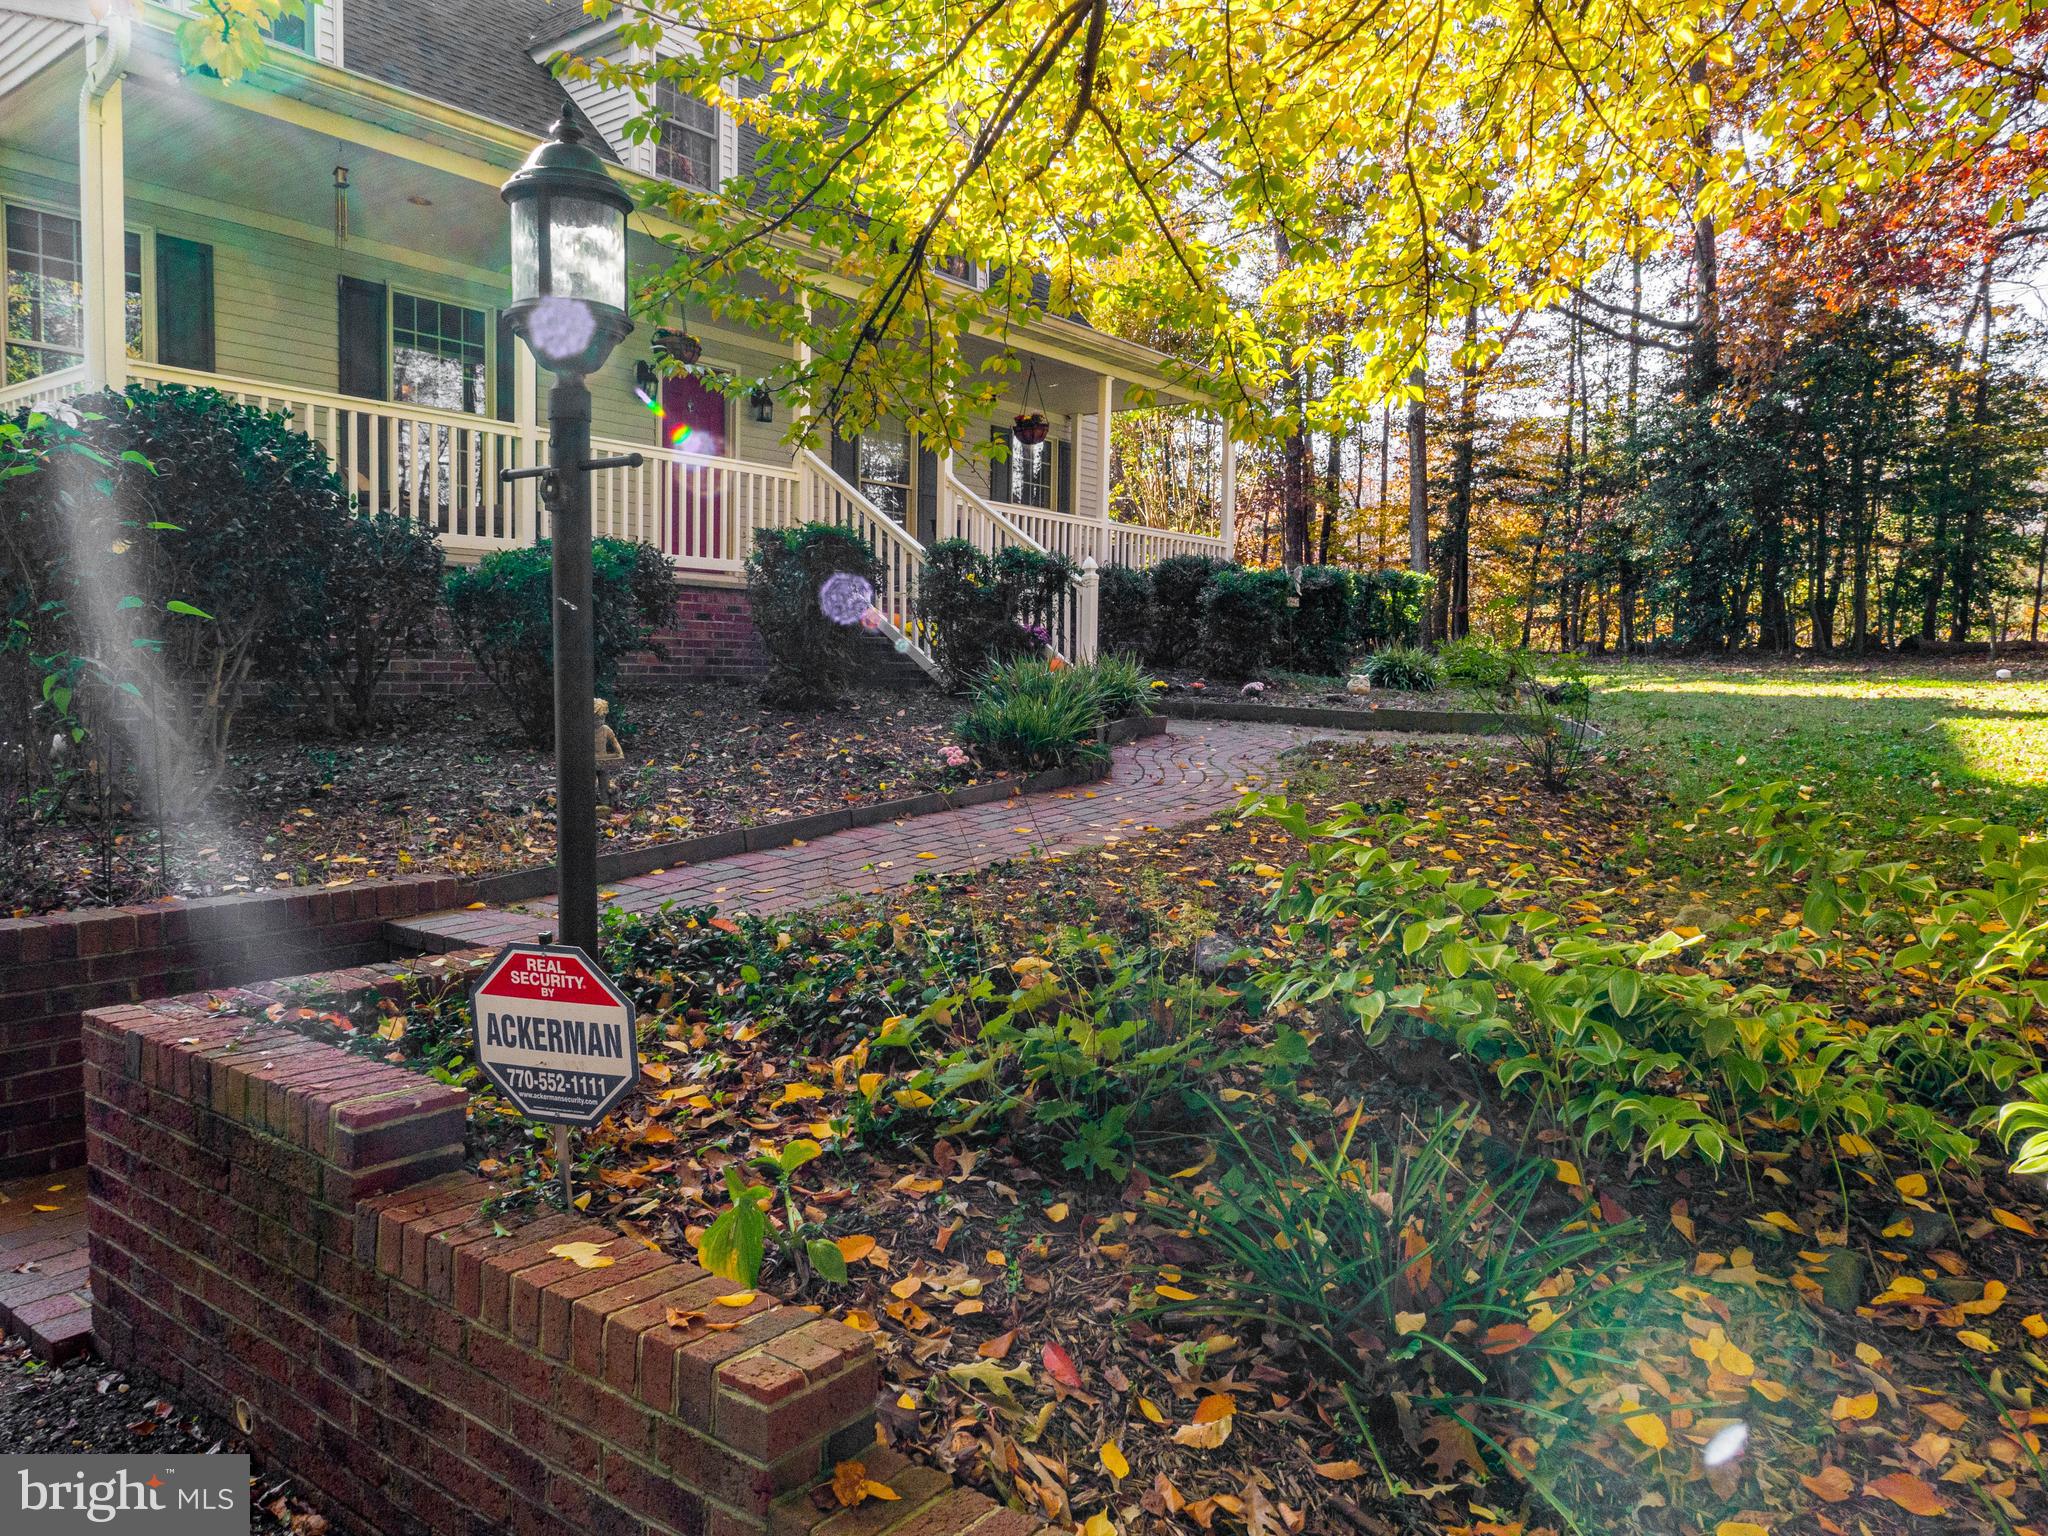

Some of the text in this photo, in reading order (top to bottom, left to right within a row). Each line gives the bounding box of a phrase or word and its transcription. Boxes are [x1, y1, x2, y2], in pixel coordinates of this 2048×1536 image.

[526, 958, 566, 974] REAL
[541, 987, 554, 997] BY
[487, 1012, 623, 1059] ACKERMAN
[506, 1068, 606, 1097] 770-552-1111
[518, 1091, 598, 1106] www.ackermansecurity.com
